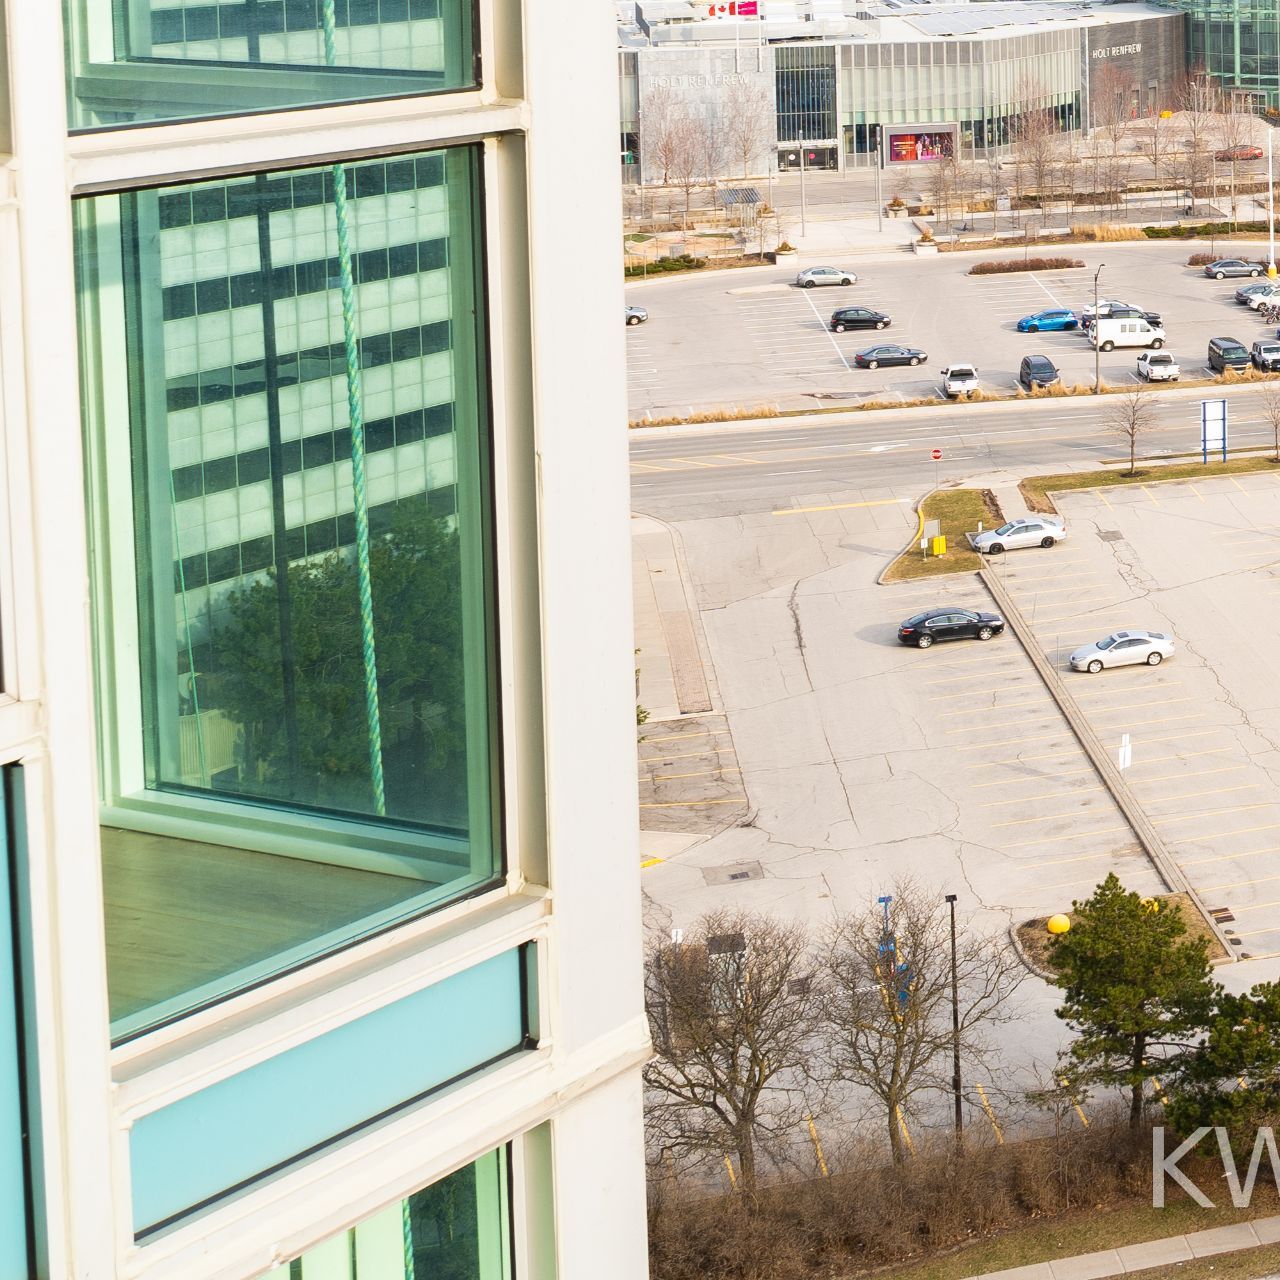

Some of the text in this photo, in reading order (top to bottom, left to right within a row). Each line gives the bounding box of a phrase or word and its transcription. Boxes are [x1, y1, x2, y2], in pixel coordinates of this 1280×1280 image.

[1092, 43, 1142, 59] HOLT RENFREW
[650, 73, 749, 88] HOLT RENFREW
